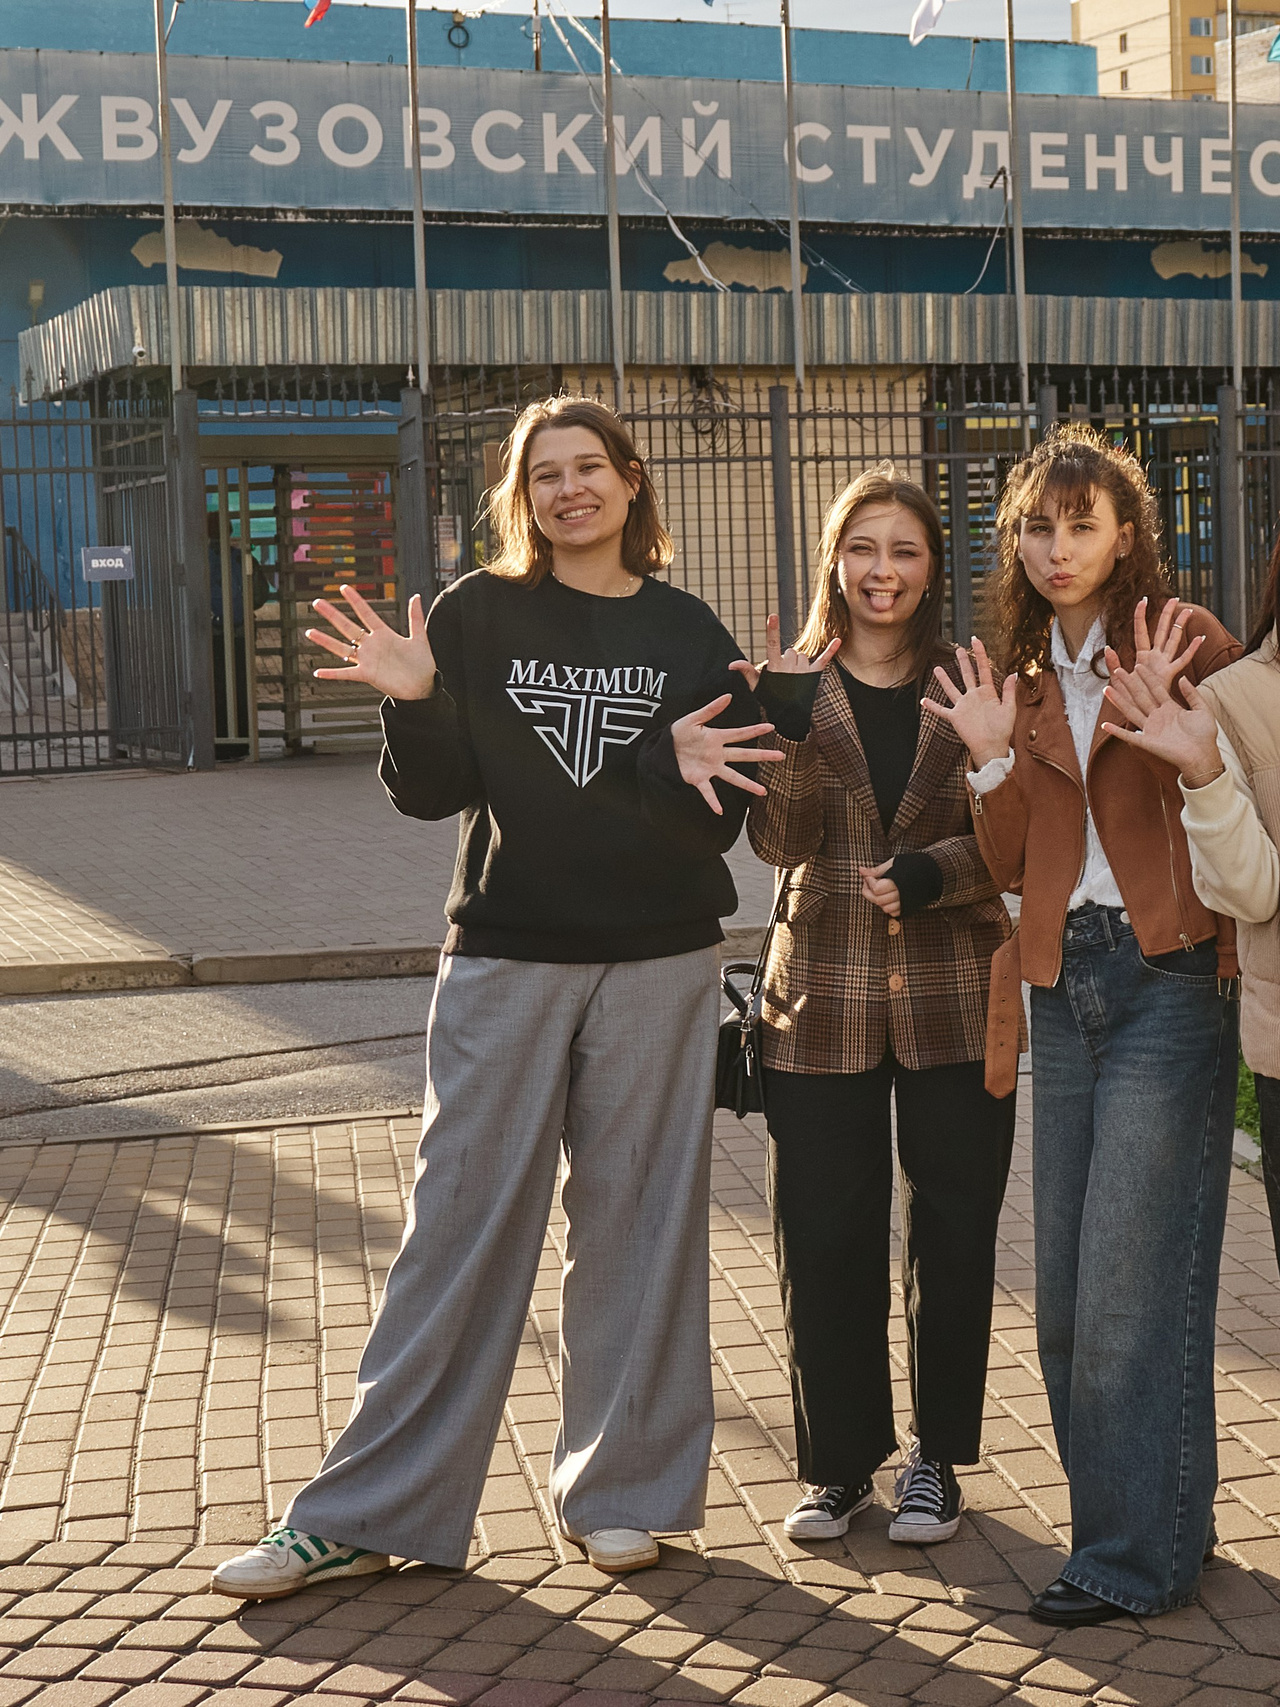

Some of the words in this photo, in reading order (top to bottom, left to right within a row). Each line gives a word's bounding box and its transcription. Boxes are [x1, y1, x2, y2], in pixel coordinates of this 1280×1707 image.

[0, 93, 731, 178] ЖВУЗОВСКИЙ
[91, 558, 124, 568] ВХОД
[507, 659, 667, 700] MAXIMUM
